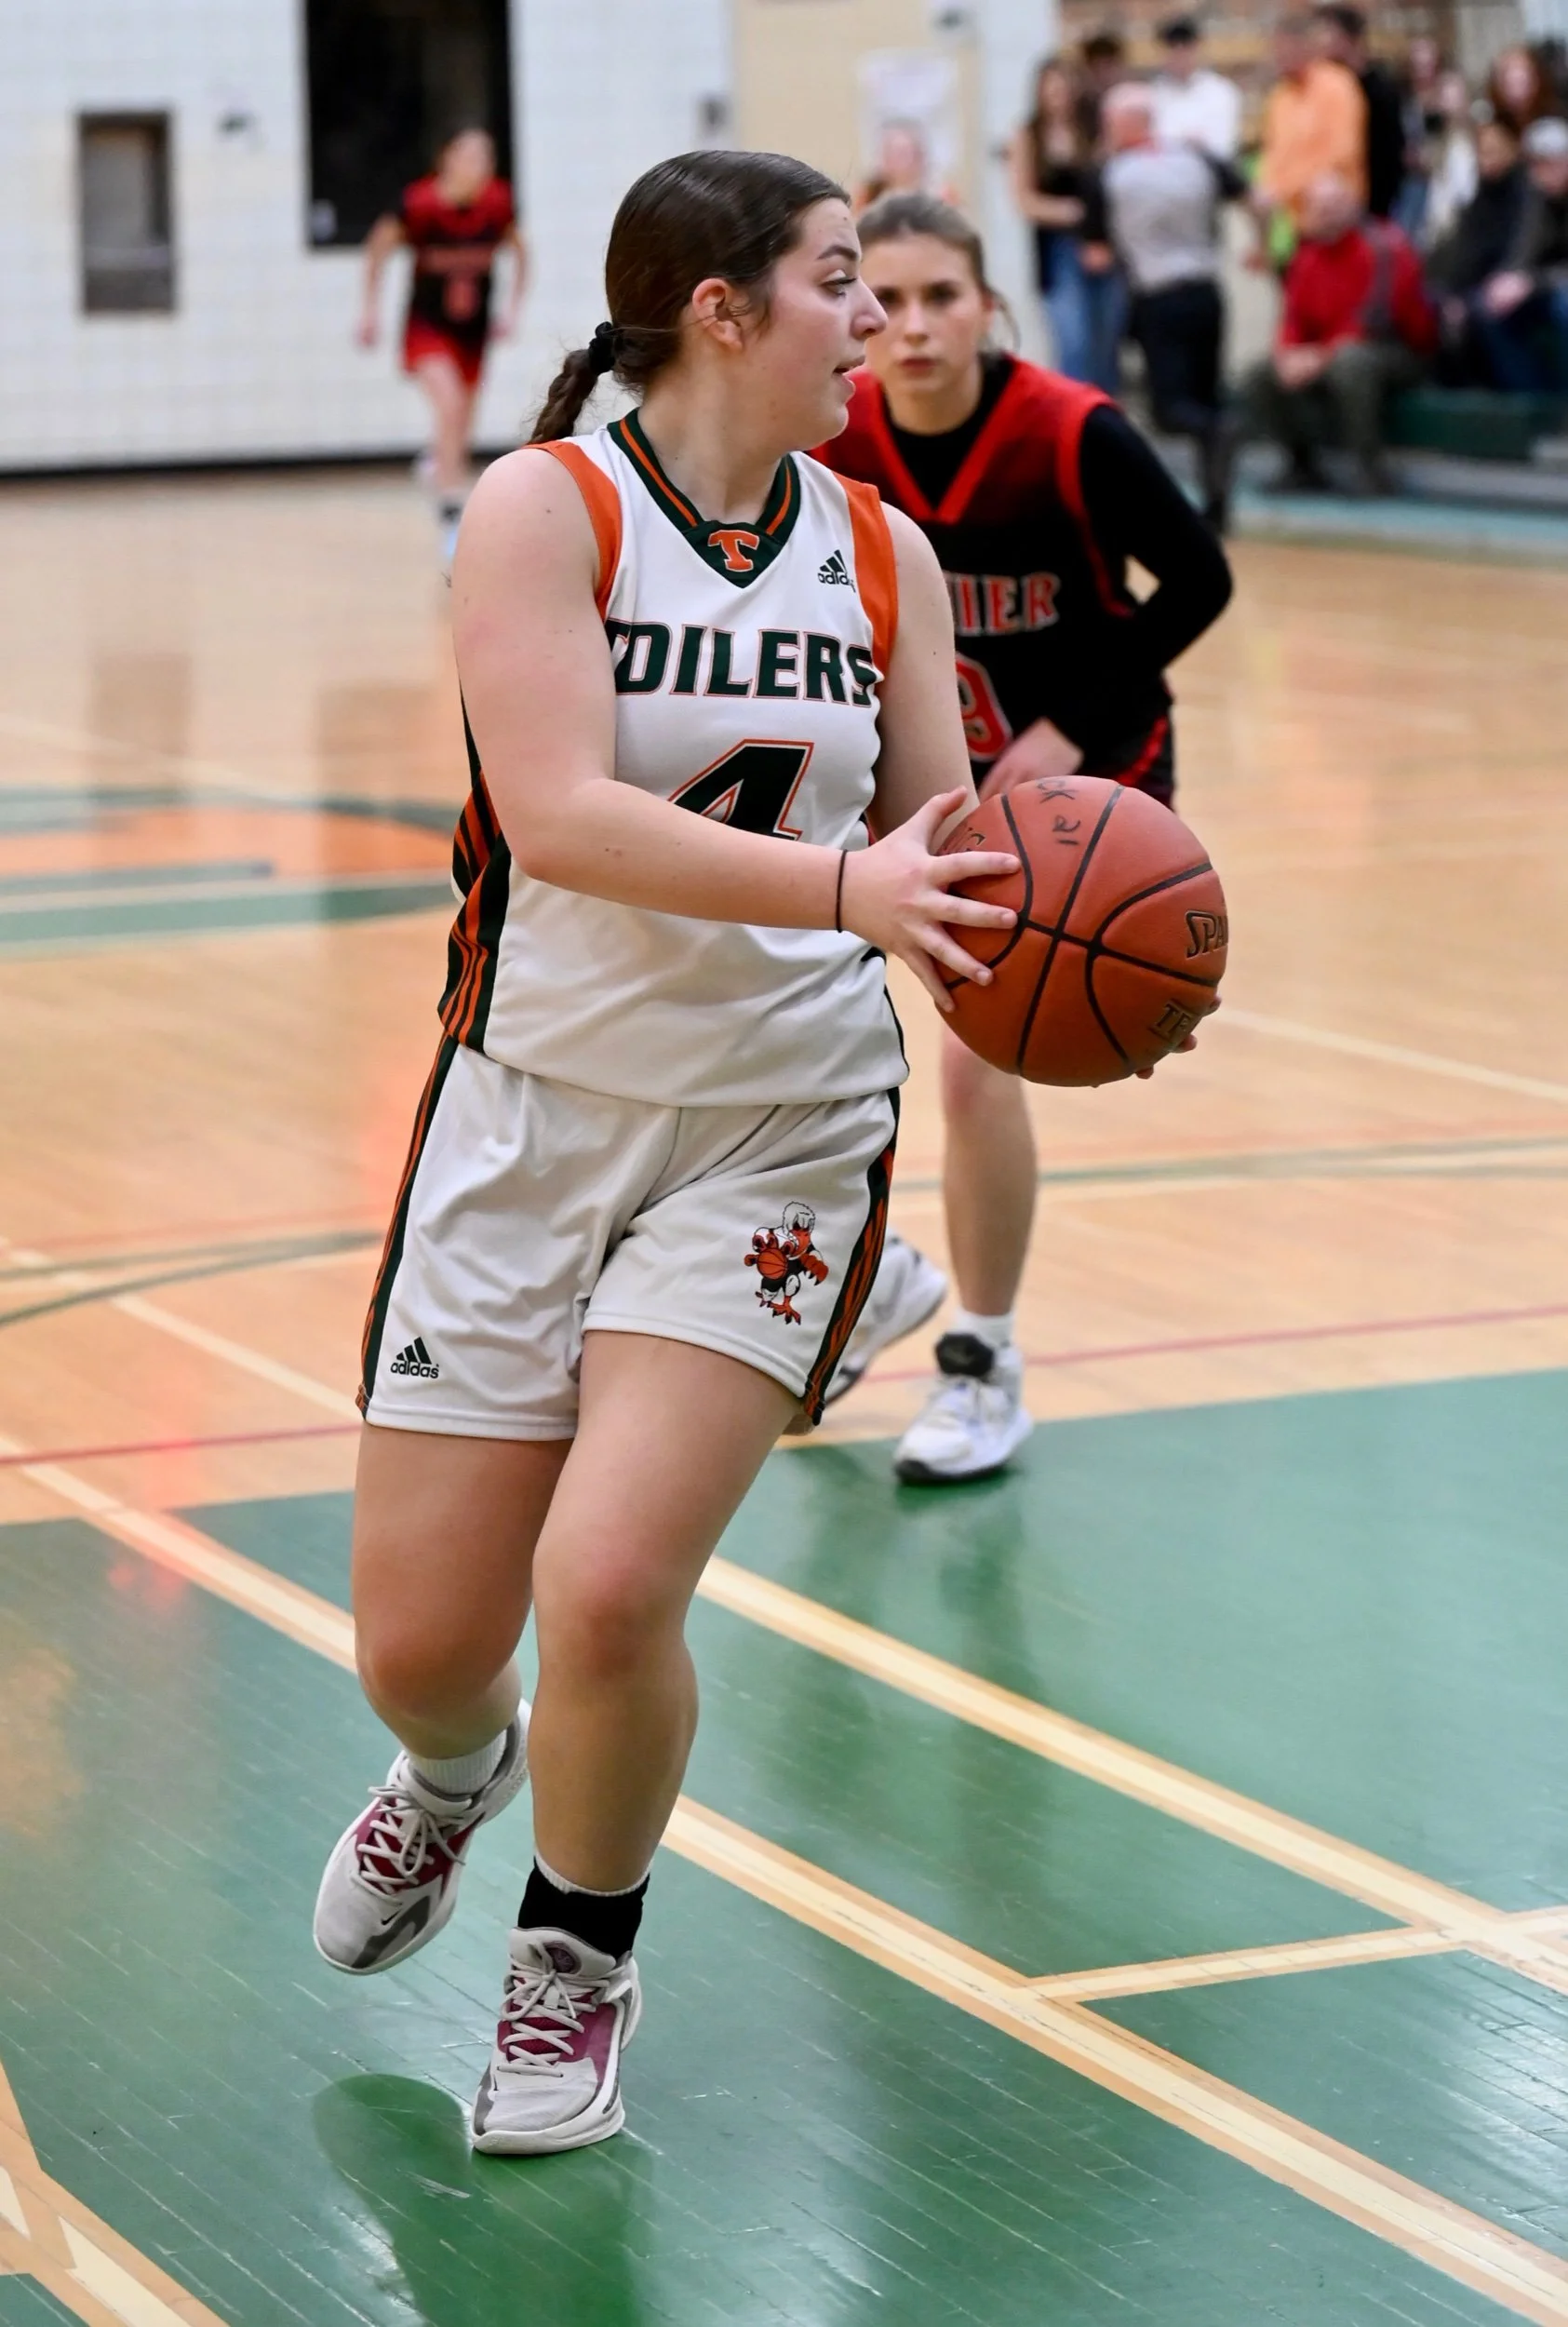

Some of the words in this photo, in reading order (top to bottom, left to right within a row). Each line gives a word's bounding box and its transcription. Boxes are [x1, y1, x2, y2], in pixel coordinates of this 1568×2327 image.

[707, 529, 760, 572] T
[943, 570, 1061, 638] IER
[667, 738, 815, 841] 4
[390, 1360, 440, 1379] adidas
